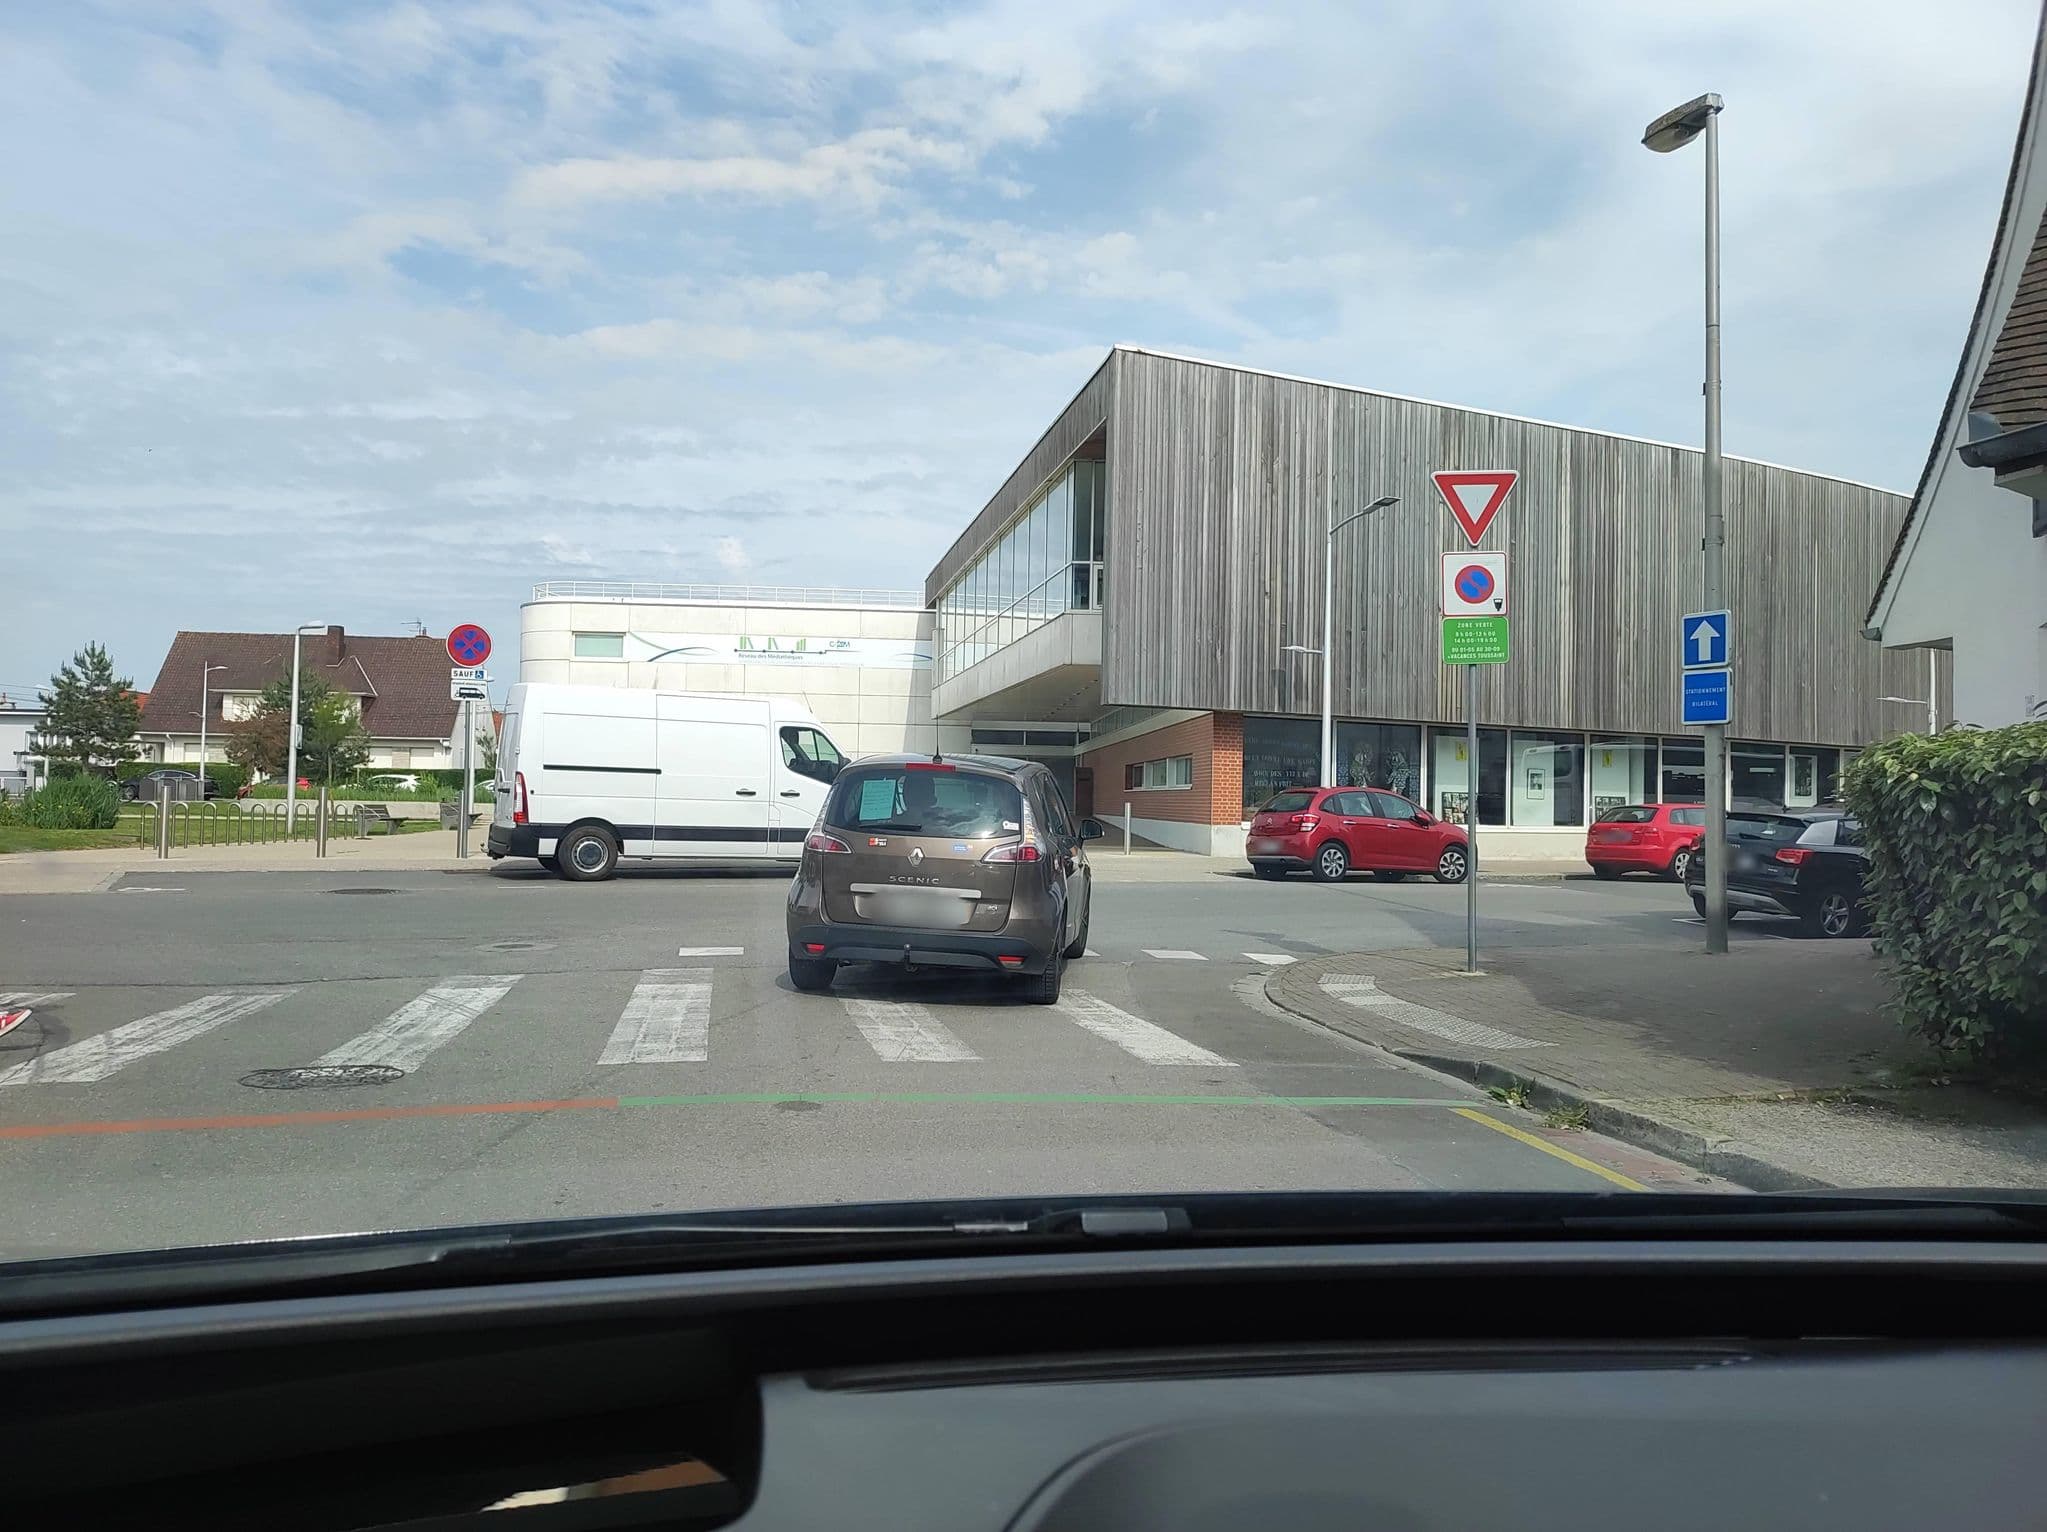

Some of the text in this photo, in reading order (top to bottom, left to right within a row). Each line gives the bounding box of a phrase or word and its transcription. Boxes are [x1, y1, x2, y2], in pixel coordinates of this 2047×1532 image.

[453, 670, 475, 678] SAUF
[1685, 687, 1726, 695] STATIONNEMENT
[888, 875, 941, 885] SCENIC
